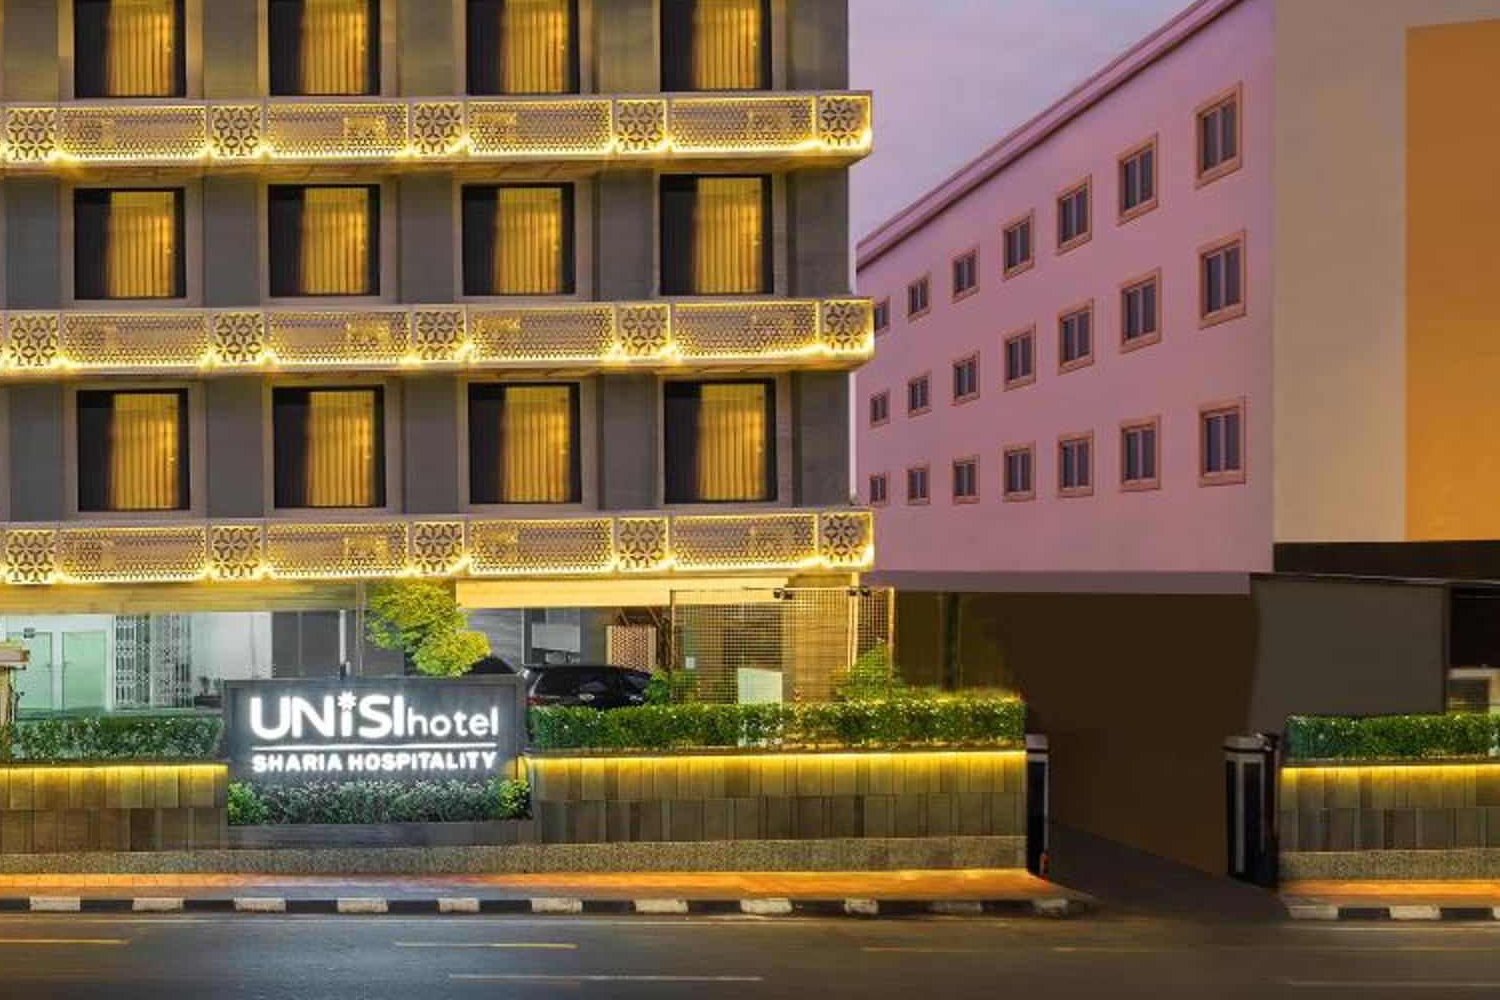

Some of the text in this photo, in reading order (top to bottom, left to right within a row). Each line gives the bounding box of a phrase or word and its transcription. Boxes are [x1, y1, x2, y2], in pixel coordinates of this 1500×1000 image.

[407, 706, 499, 737] hotel
[251, 751, 498, 773] SHARIA HOSPITALITY
